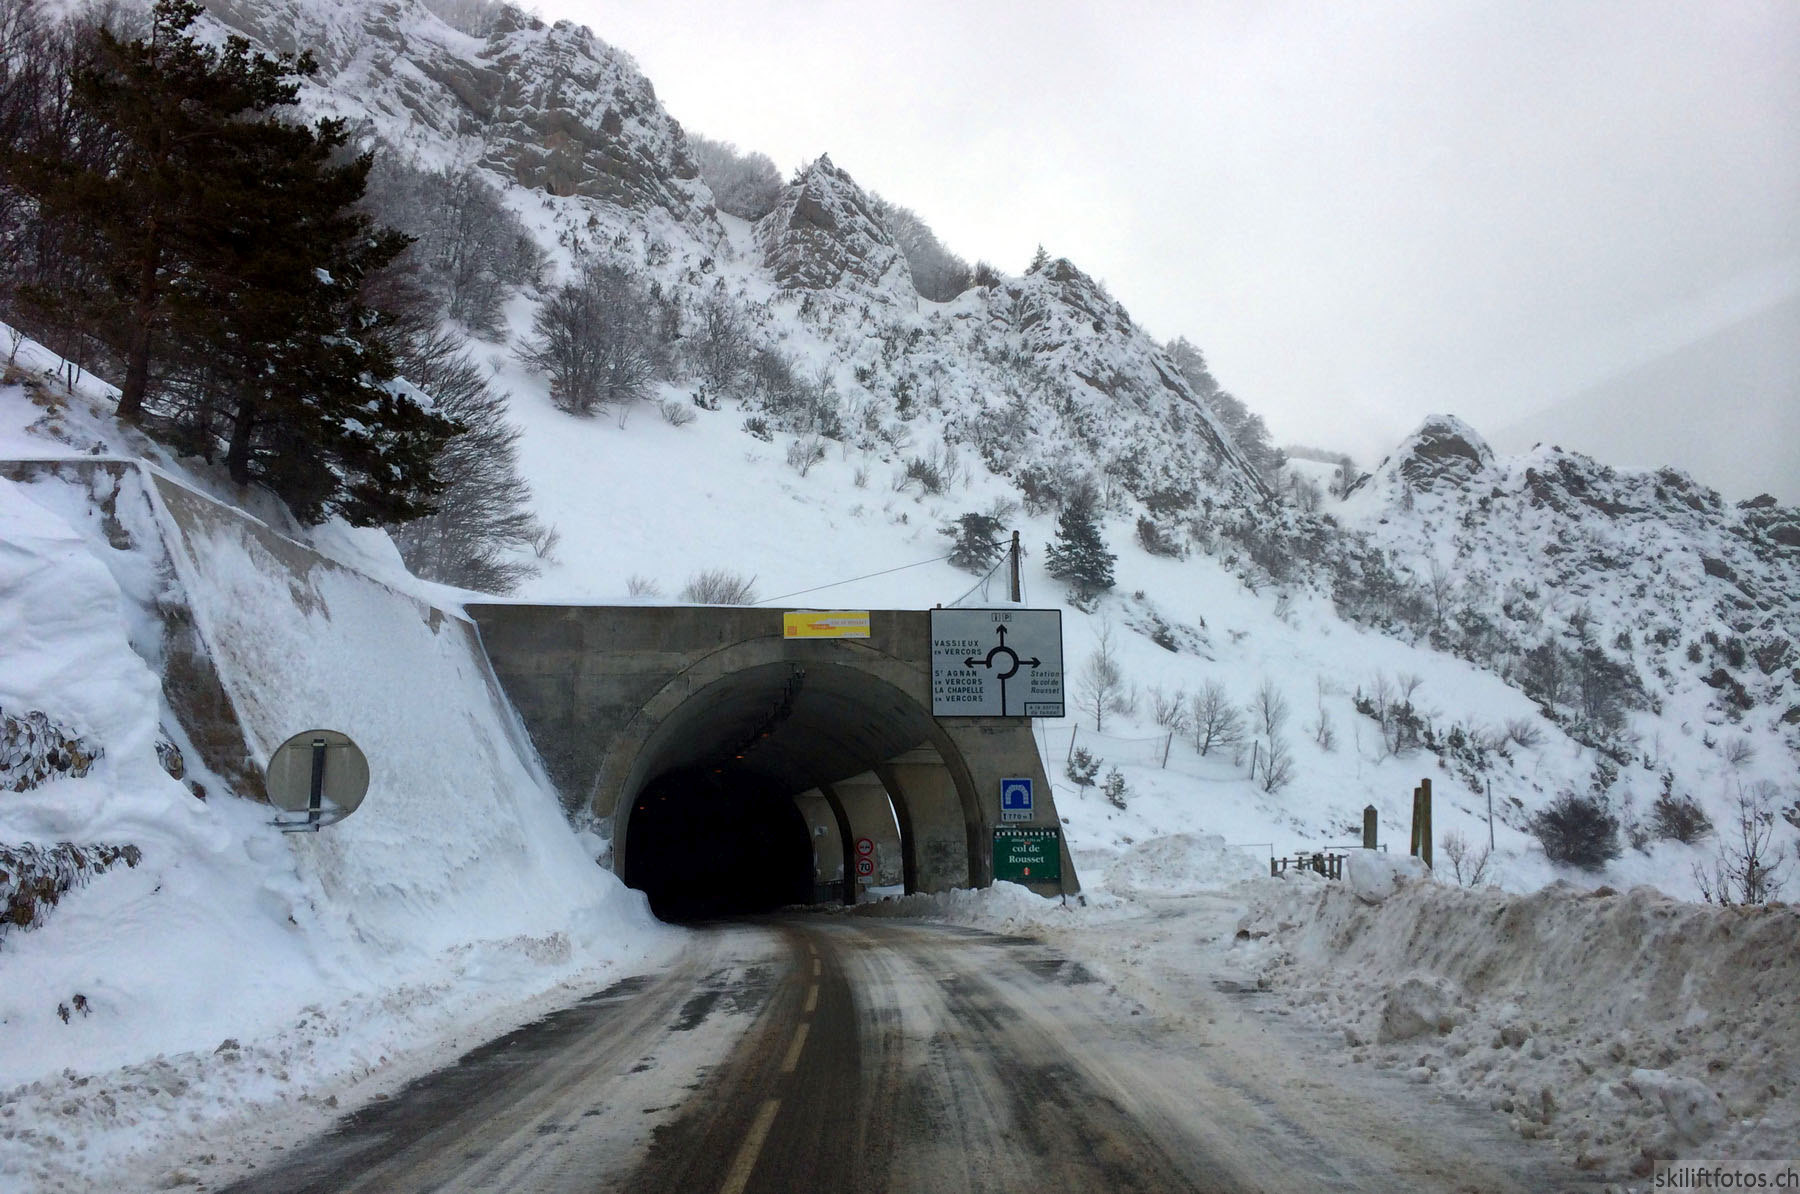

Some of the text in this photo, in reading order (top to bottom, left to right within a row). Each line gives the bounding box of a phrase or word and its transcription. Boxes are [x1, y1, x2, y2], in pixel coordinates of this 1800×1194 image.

[1030, 687, 1060, 695] Rousset
[1012, 844, 1040, 853] col de
[1009, 855, 1044, 864] Rousset
[860, 863, 870, 871] 70
